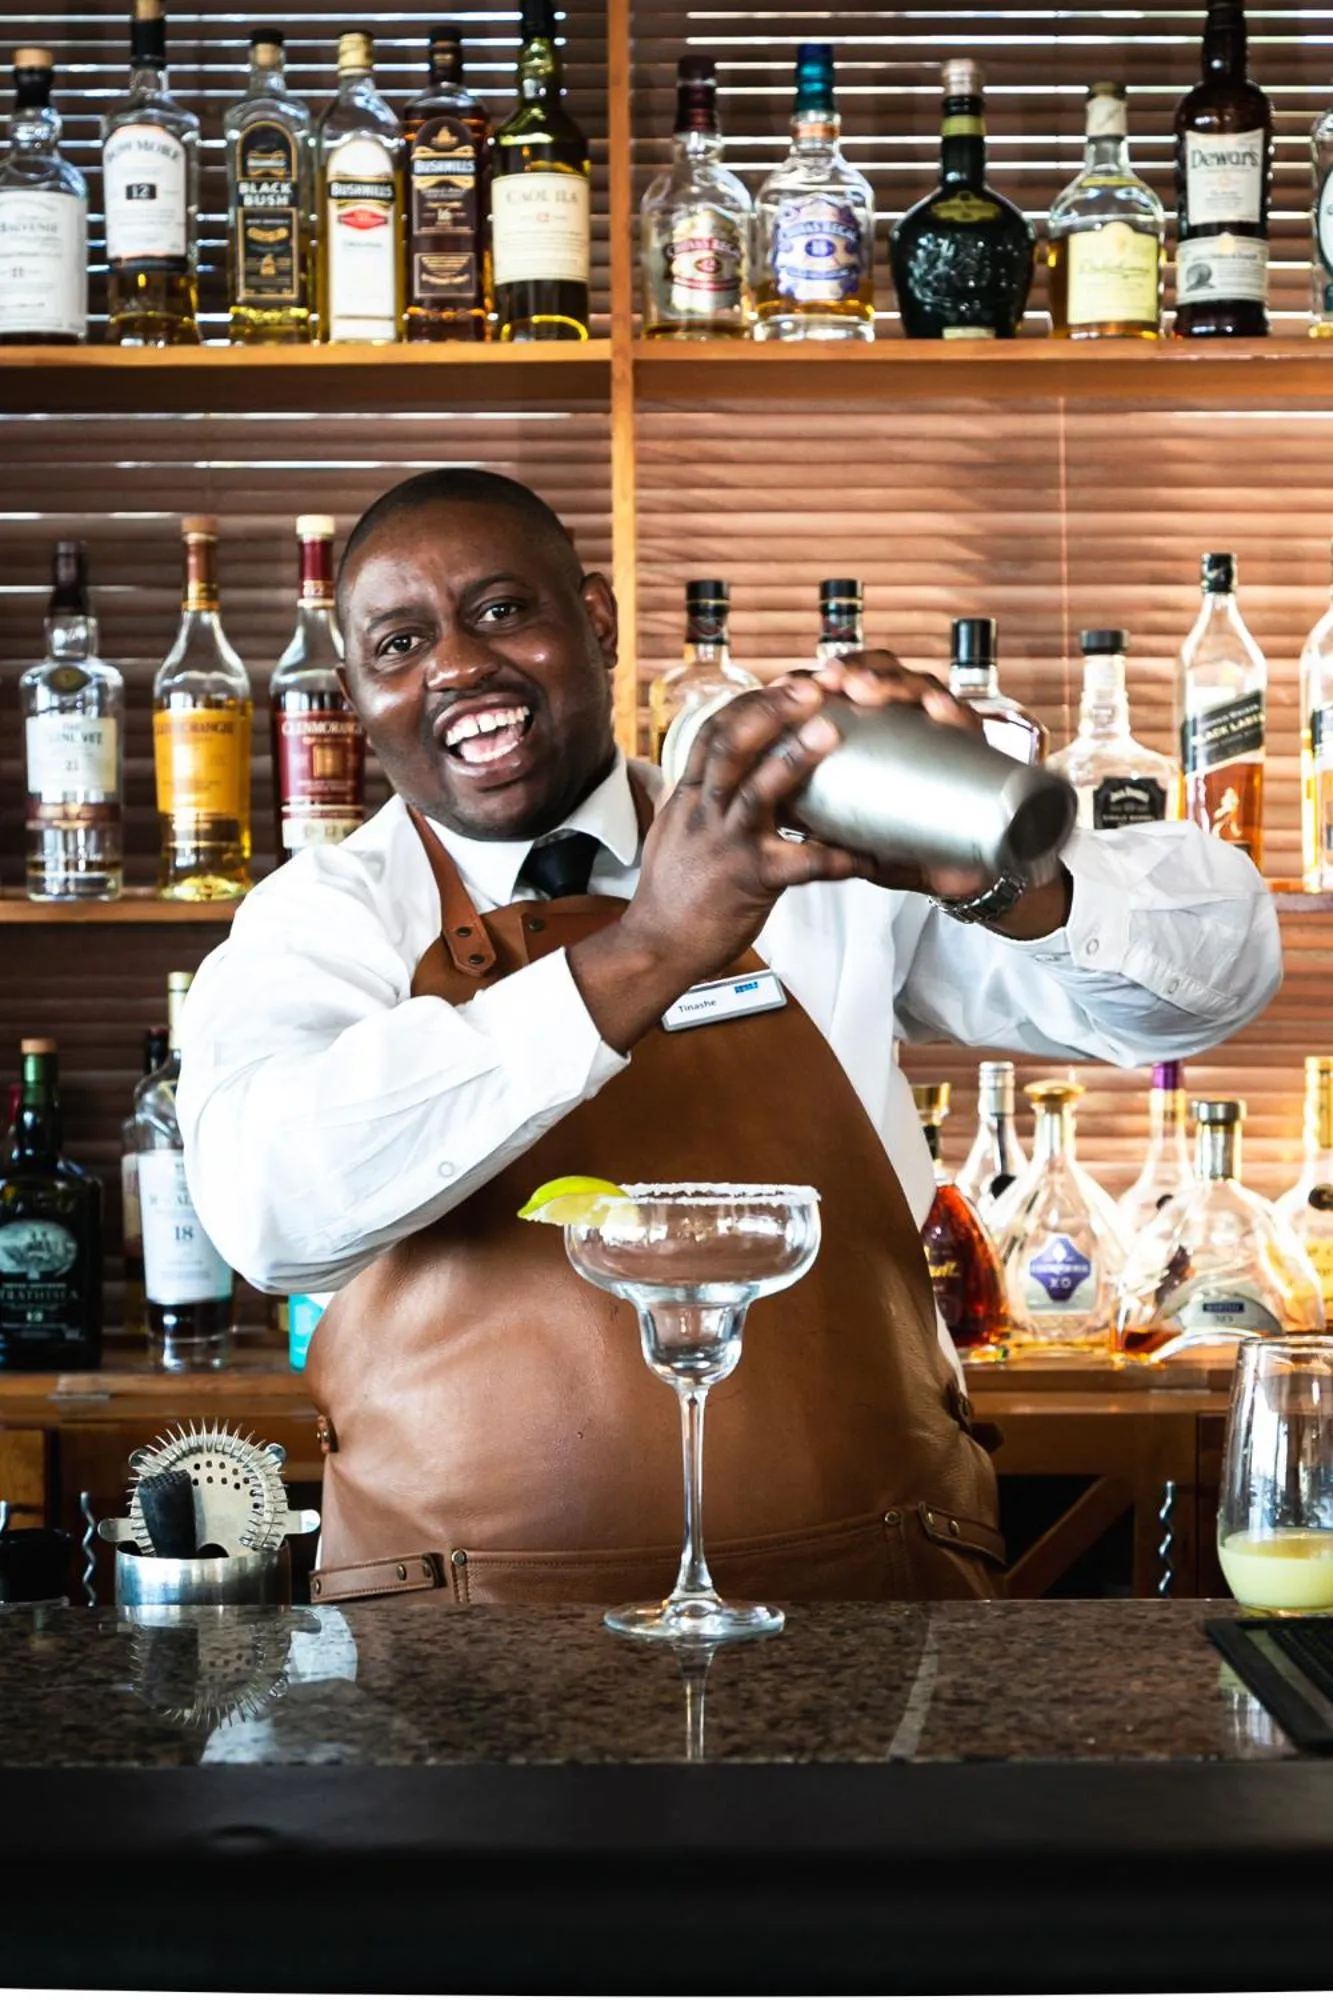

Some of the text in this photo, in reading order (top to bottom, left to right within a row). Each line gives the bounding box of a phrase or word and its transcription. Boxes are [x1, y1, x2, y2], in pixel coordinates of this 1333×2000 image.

[414, 159, 476, 174] BUSHMILLS
[132, 184, 150, 199] 12
[239, 182, 292, 194] BLACK
[330, 182, 393, 198] BUSHMILLS
[243, 194, 289, 206] BUSH
[677, 1000, 717, 1013] Tinashe
[174, 1225, 194, 1241] 18
